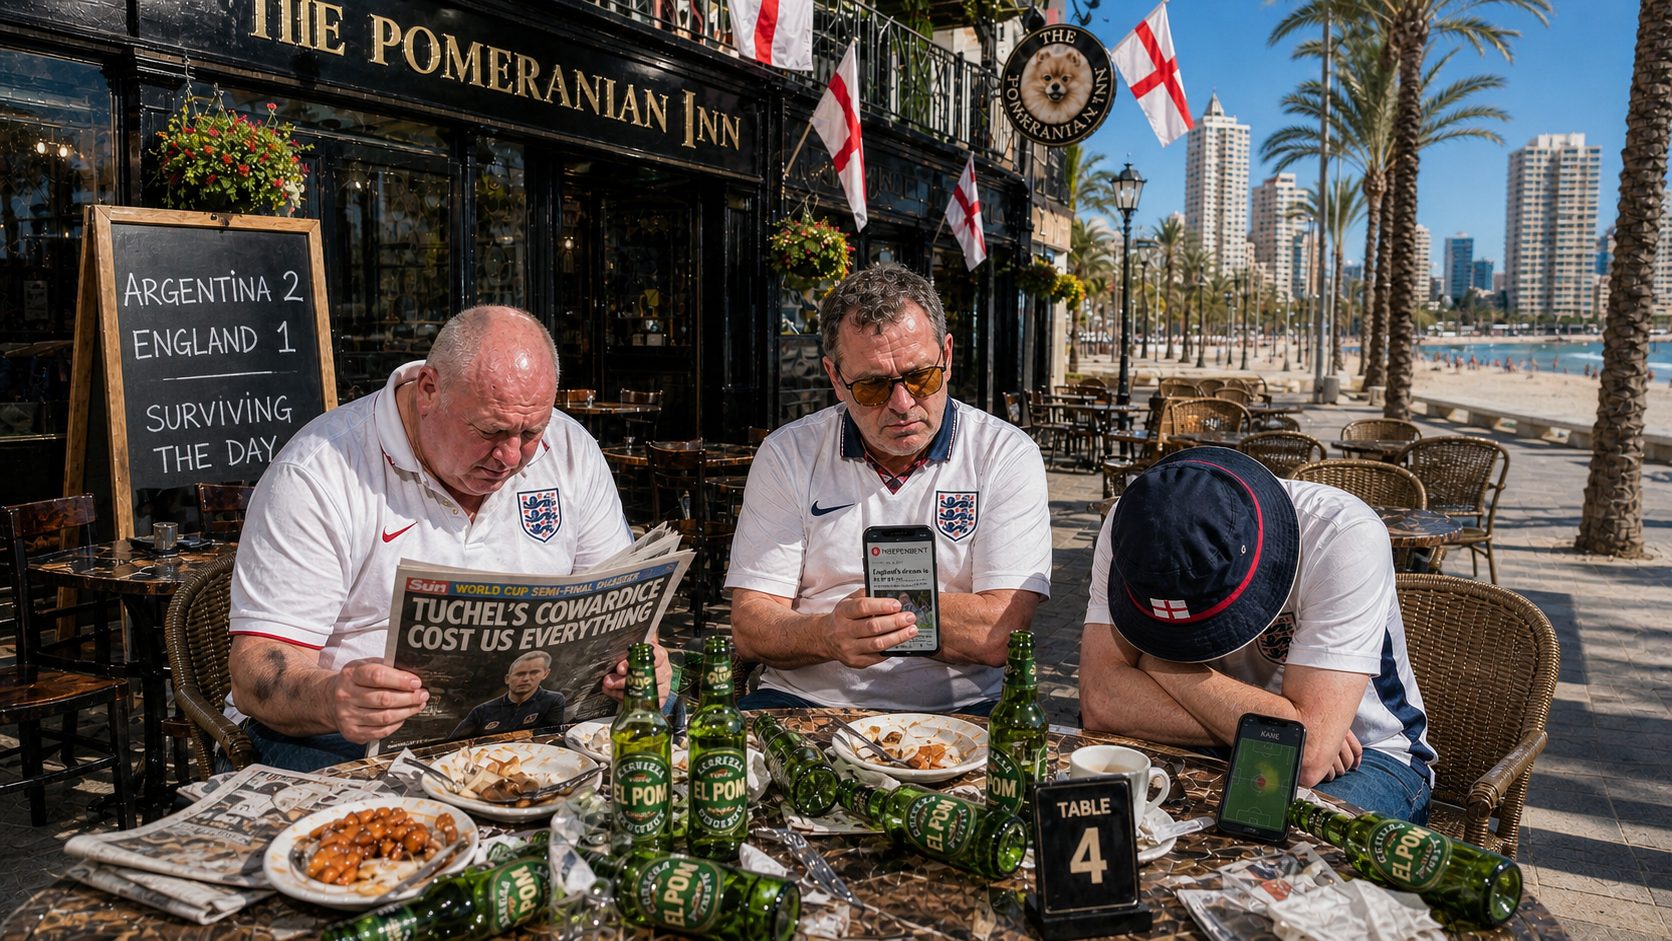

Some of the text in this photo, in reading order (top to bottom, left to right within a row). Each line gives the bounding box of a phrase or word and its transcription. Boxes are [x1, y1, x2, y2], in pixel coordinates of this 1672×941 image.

[1040, 29, 1077, 44] THE
[368, 13, 668, 133] POMERANIAN
[682, 89, 741, 150] INN
[1007, 67, 1108, 139] POMERANIAN INN
[124, 270, 303, 306] ARGENTINA 2
[133, 321, 296, 360] ENGLAND 1
[146, 392, 292, 432] SURVIVING
[153, 435, 277, 473] THE DAY
[408, 579, 447, 593] Sun
[412, 577, 665, 627] TUCHEL'S COWARDICE
[456, 584, 500, 595] WORLD
[504, 585, 529, 597] CUP
[531, 582, 593, 597] SEMI-FINAL
[407, 602, 653, 651] COST US EVERYTHING
[1260, 730, 1280, 740] KANE
[613, 782, 668, 806] EL POM
[694, 777, 746, 802] EL POM
[928, 799, 957, 831] POM
[1057, 797, 1111, 818] TABLE
[927, 833, 943, 852] EL
[1070, 826, 1107, 884] 4
[1394, 827, 1431, 860] POM
[1392, 862, 1411, 882] EL
[664, 907, 685, 927] EL
